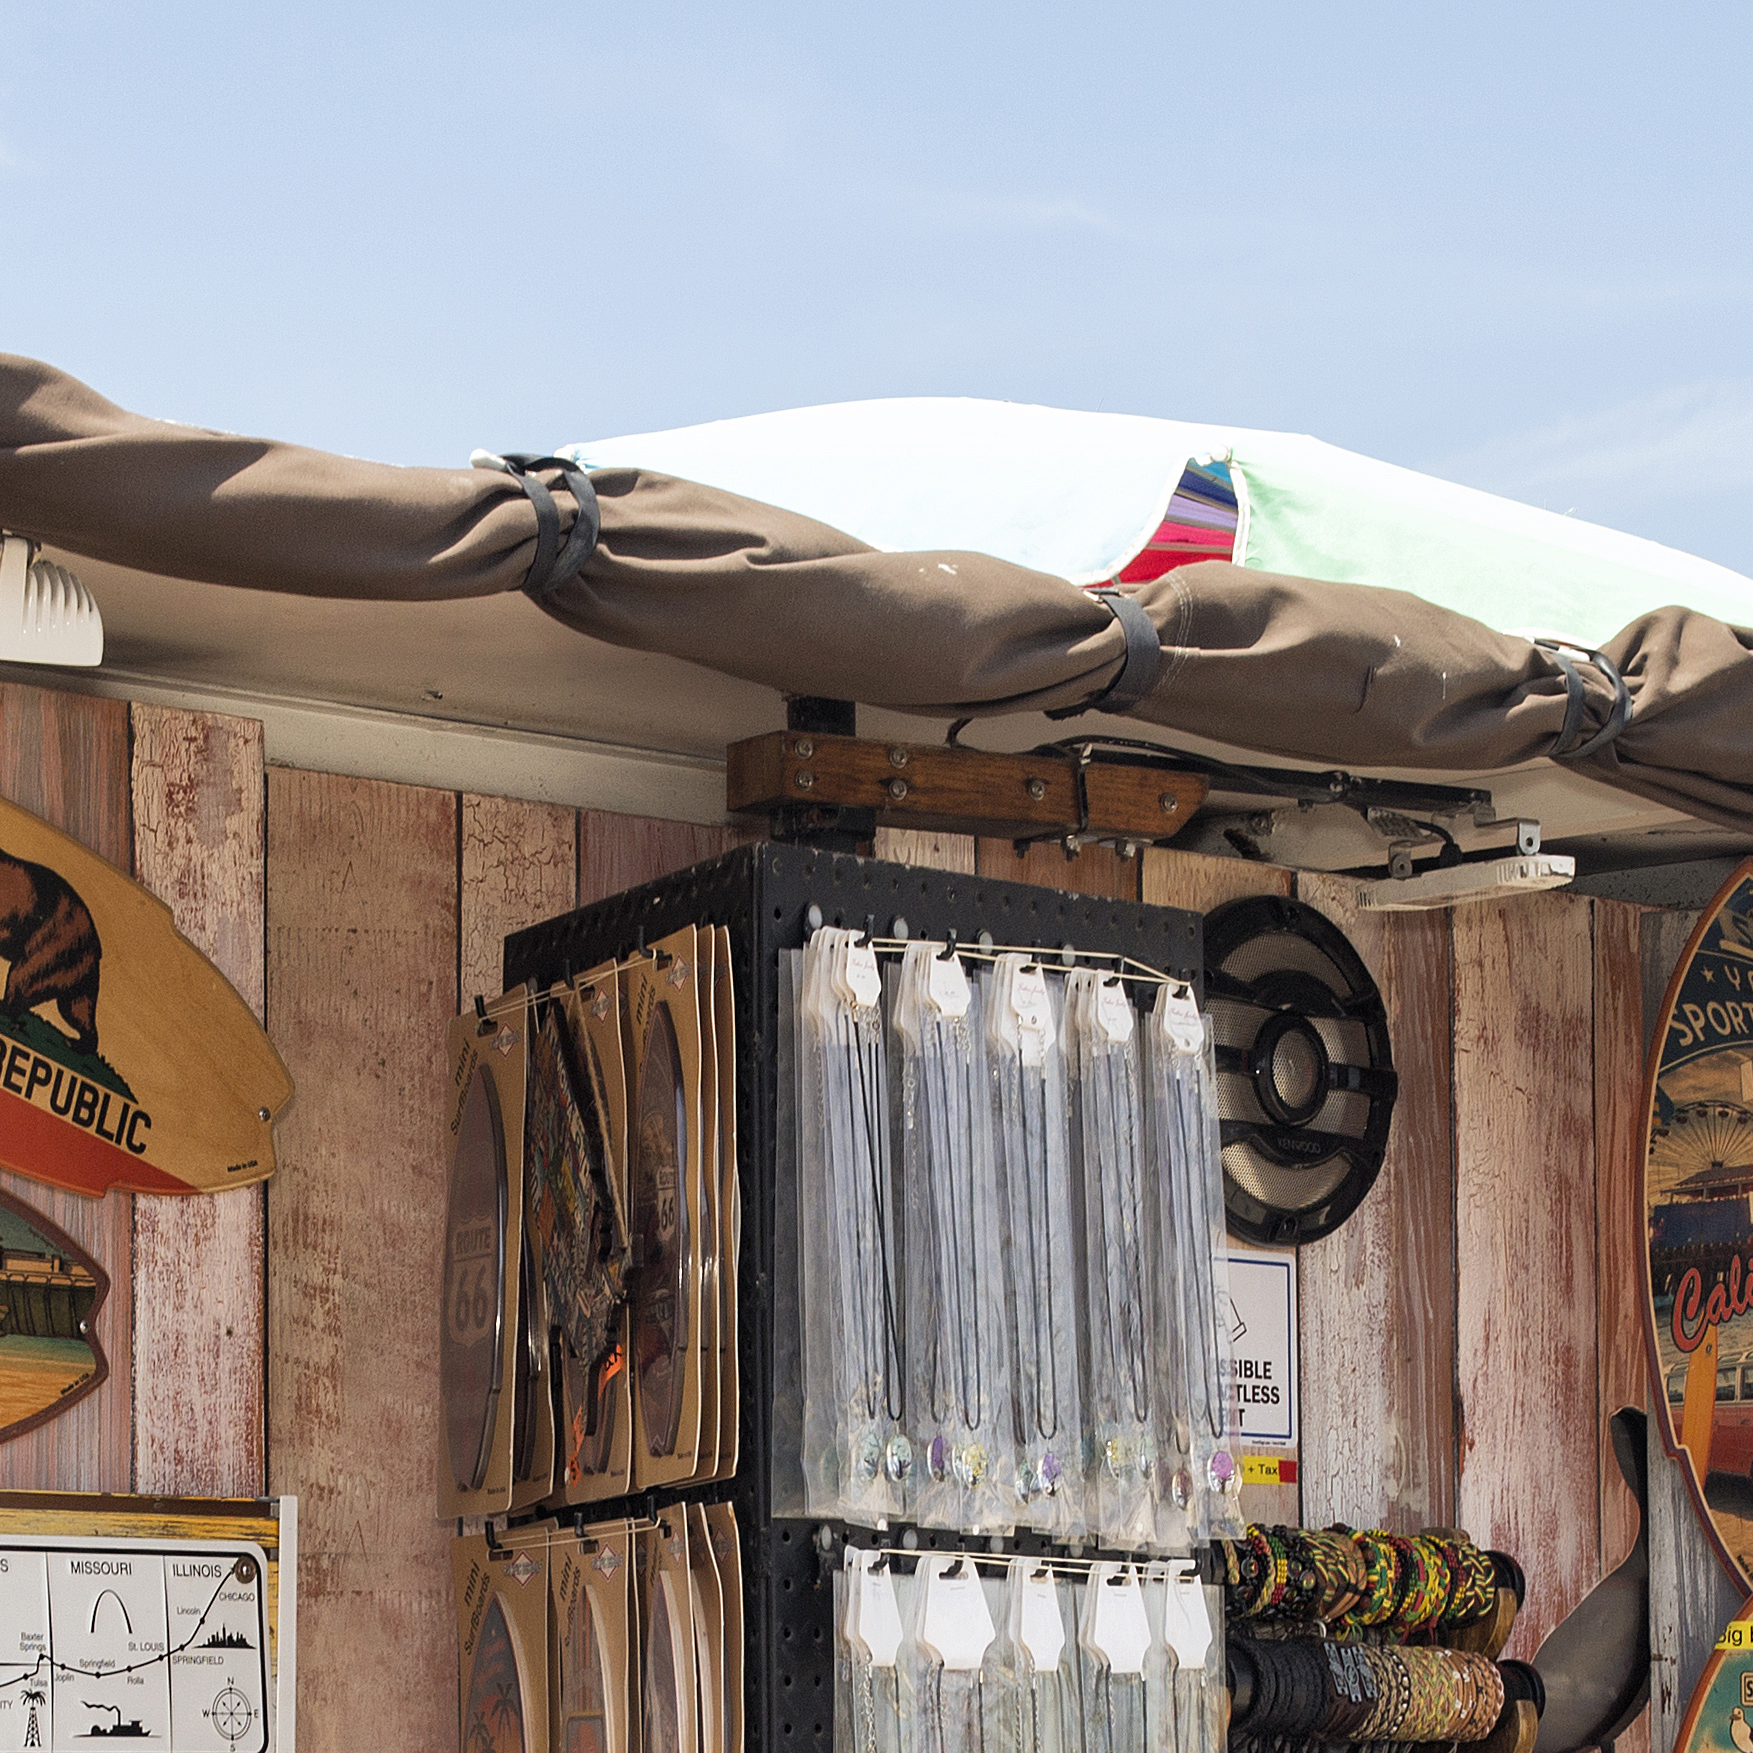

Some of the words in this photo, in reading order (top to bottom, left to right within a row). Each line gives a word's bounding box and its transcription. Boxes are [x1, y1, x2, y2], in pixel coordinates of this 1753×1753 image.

[70, 1560, 133, 1576] MISSOURI
[172, 1562, 223, 1579] ILLINOIS
[218, 1591, 256, 1602] CHICAGO
[171, 1655, 225, 1666] SPRINGFIELD
